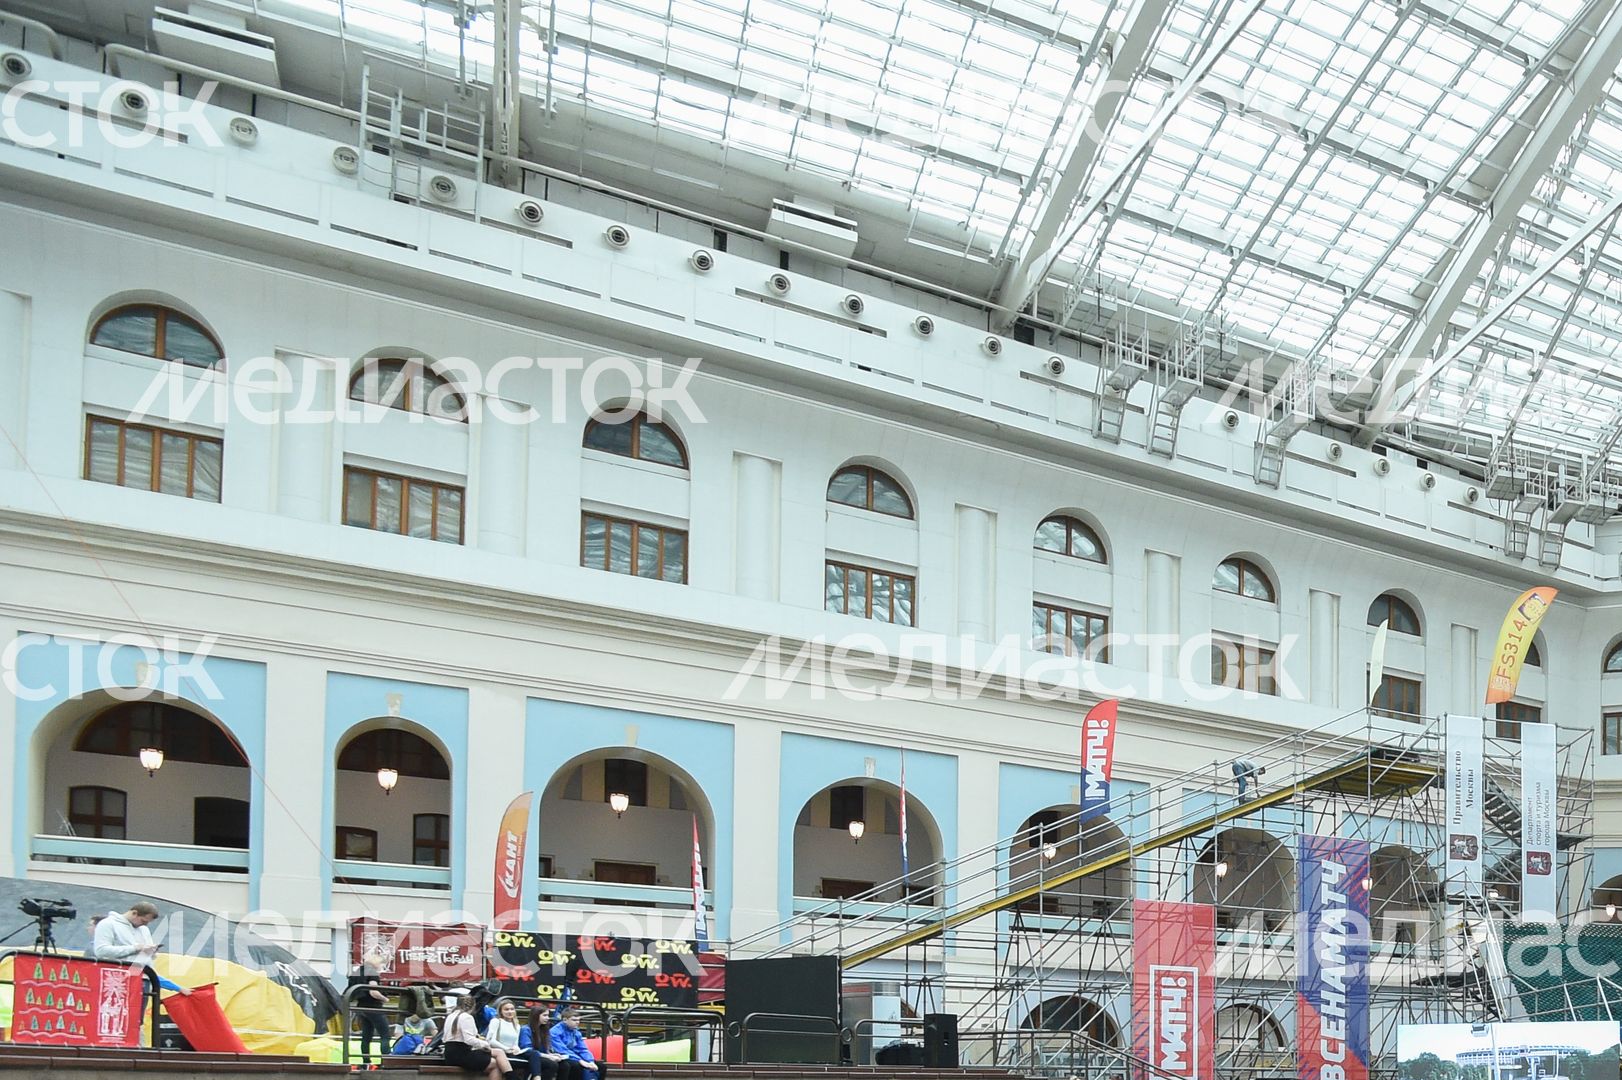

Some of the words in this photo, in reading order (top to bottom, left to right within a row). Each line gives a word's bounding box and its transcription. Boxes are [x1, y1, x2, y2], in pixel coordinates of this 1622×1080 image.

[1085, 719, 1109, 798] МАТЧ!
[1453, 751, 1463, 824] Правительство
[1466, 769, 1475, 809] Москвы
[503, 829, 519, 888] КАНТ
[1160, 976, 1188, 1071] МАТЧ!
